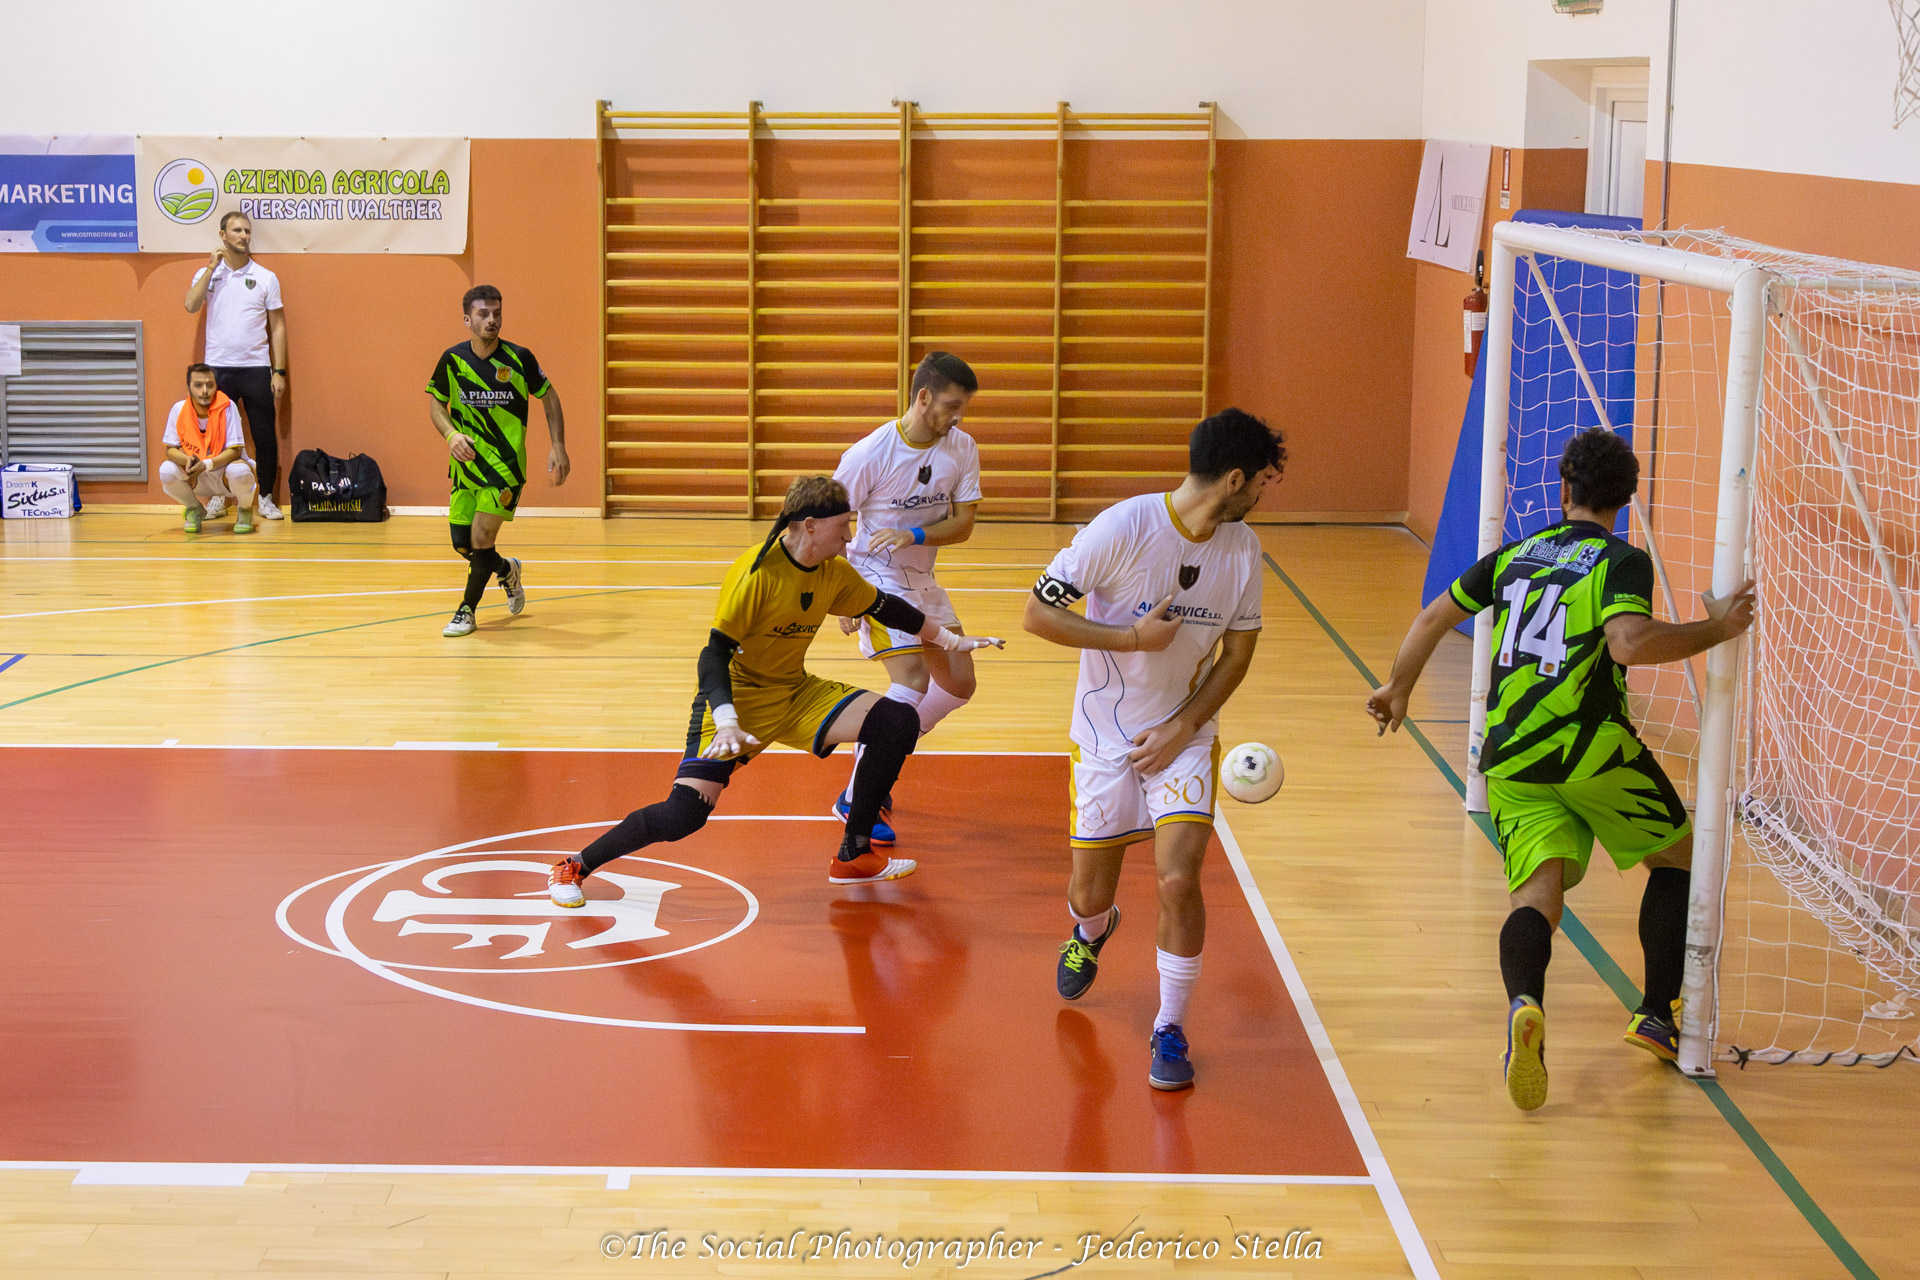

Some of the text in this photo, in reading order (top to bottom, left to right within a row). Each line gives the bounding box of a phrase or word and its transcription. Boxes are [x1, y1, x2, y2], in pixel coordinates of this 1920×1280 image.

[223, 168, 450, 195] AZIENDA AGRICOLA
[240, 198, 442, 220] PIERSANTI WALTHER
[469, 390, 514, 400] PIADINA
[1041, 580, 1064, 602] C
[1498, 577, 1567, 678] 14
[1163, 775, 1205, 805] 80
